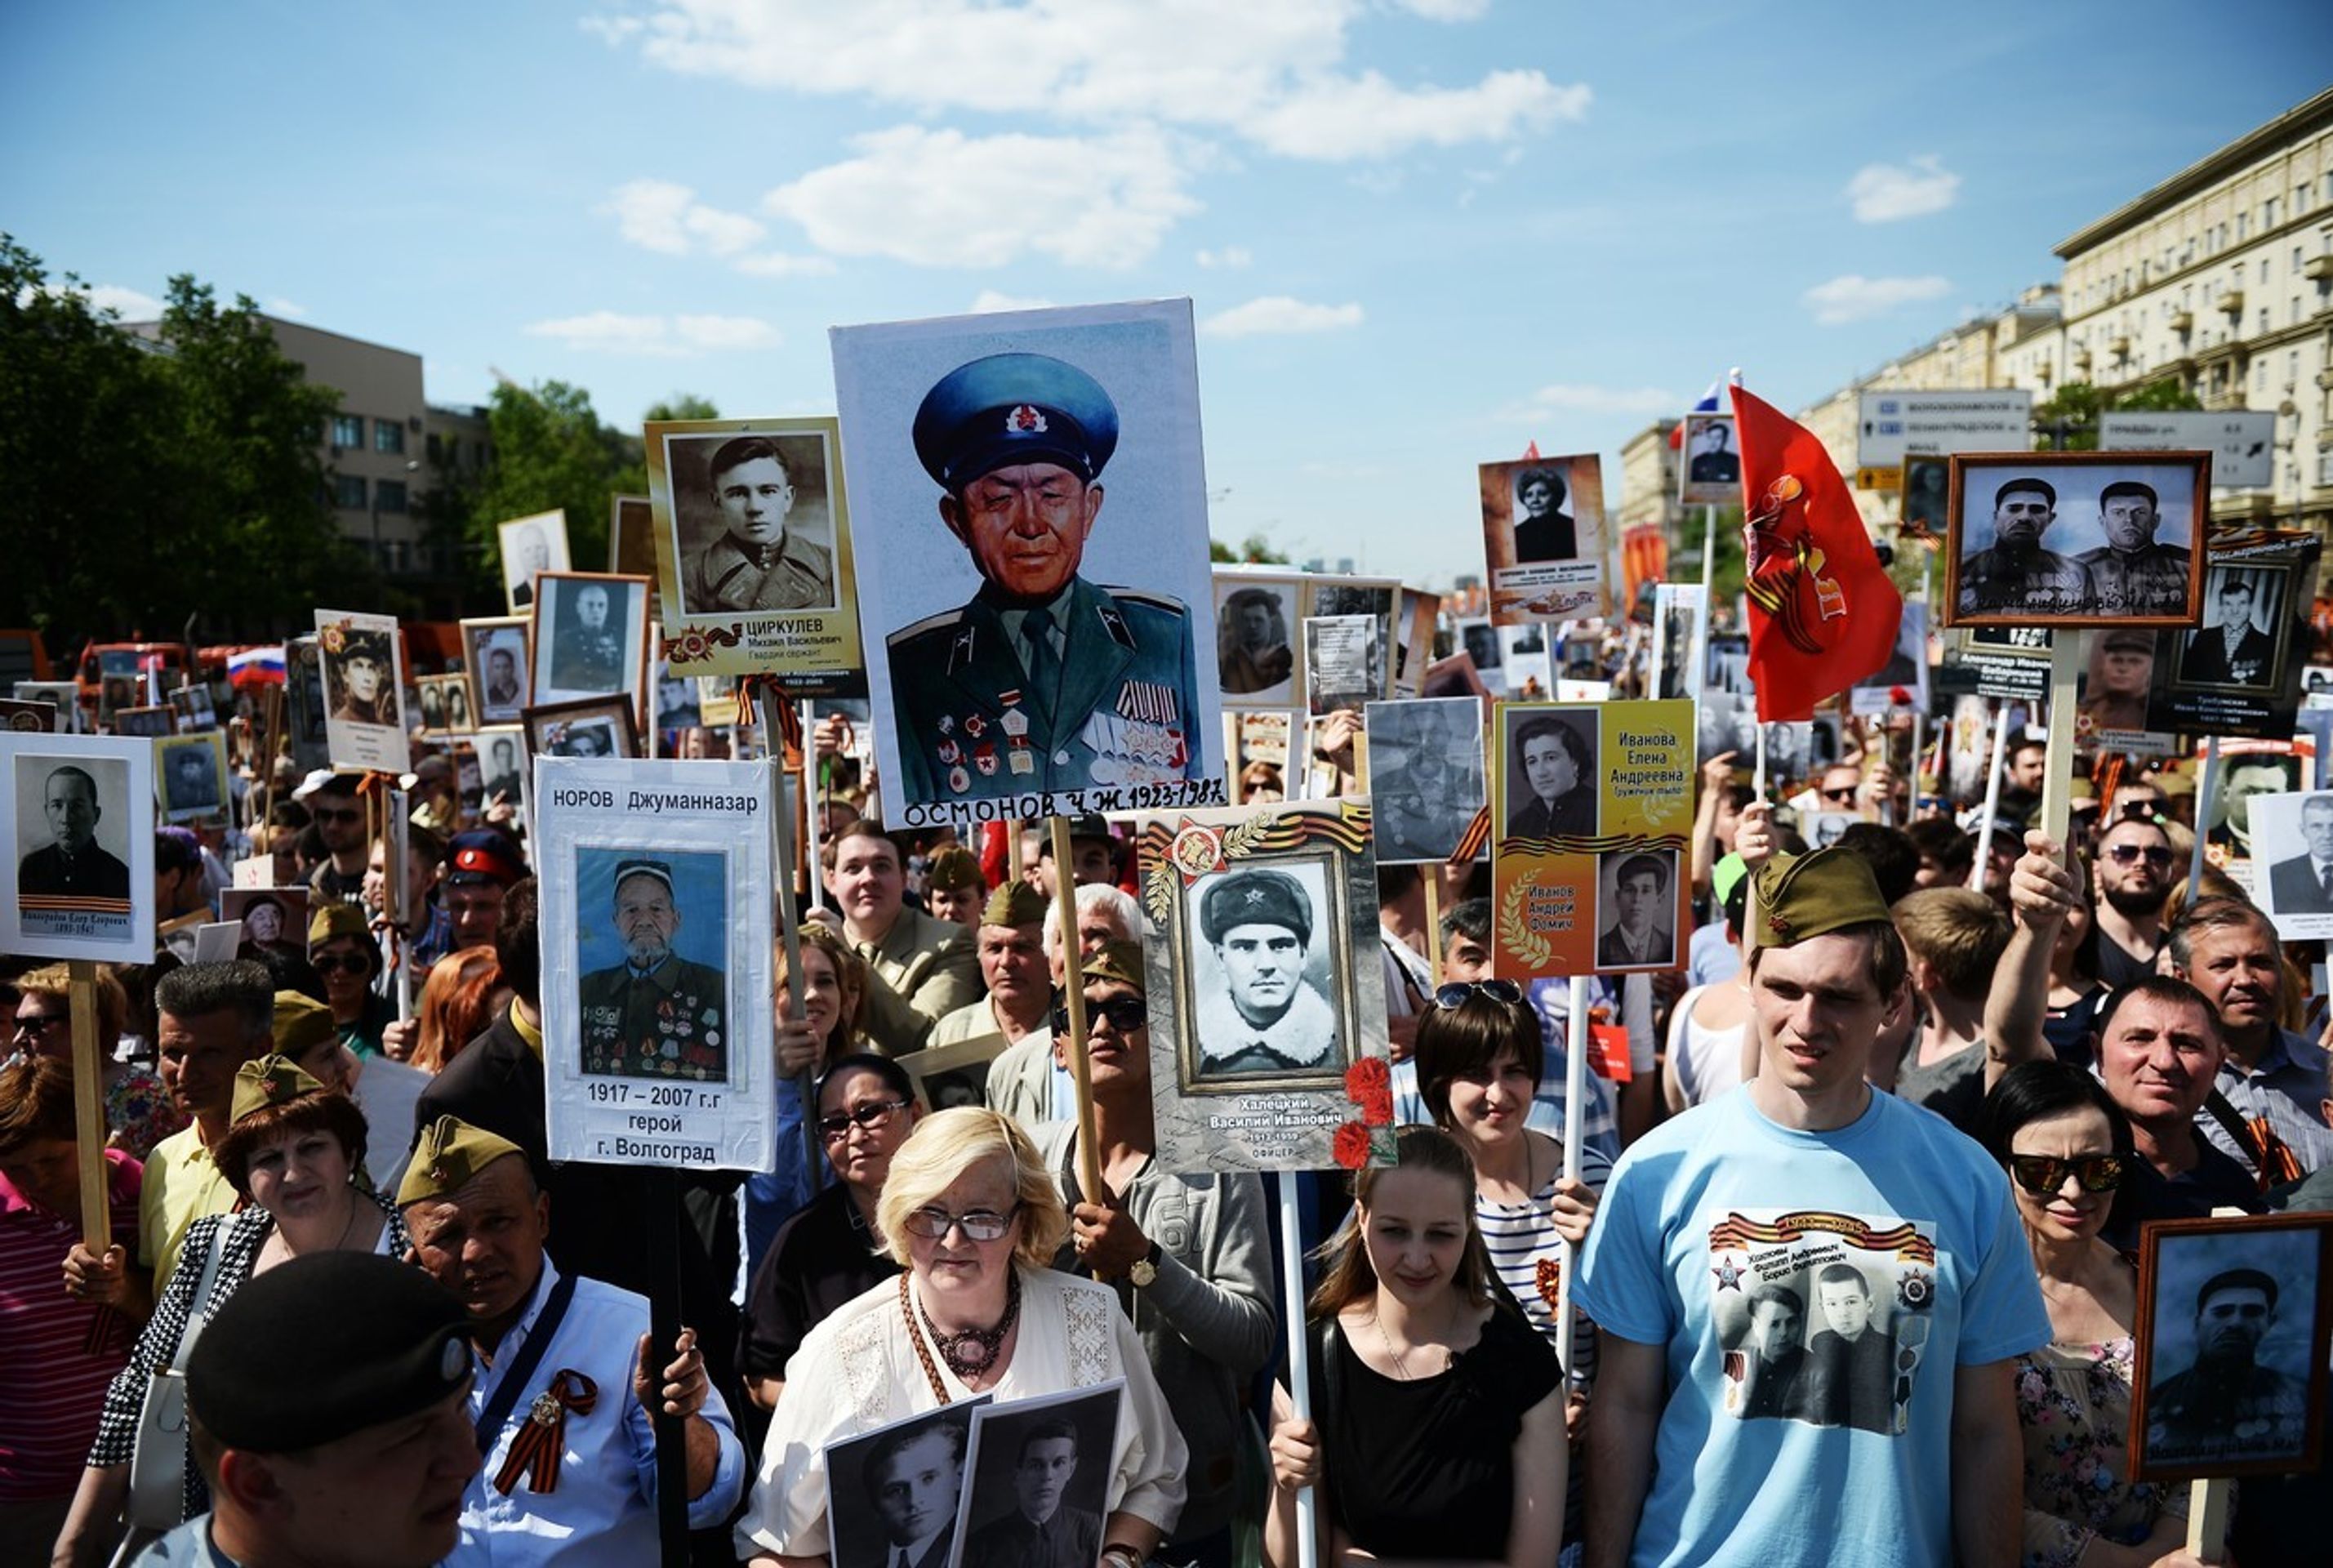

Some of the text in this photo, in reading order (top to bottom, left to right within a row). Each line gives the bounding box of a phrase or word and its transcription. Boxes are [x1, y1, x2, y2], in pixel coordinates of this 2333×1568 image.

[746, 618, 823, 636] ЦИРКУЛЕВ
[748, 635, 842, 648] Михаил Васильевич
[786, 648, 821, 659] сержант
[1619, 732, 1676, 746] Иванова
[1627, 751, 1667, 764] Елена
[1610, 769, 1684, 786] Андреевна
[554, 790, 758, 815] НОРОВ Джуманназар
[1528, 884, 1575, 898] Иванов
[1528, 902, 1575, 915] Андрей
[1530, 918, 1574, 931] Фомич
[588, 1083, 629, 1102] 1917
[651, 1086, 693, 1107] 2007
[1240, 1098, 1309, 1112] Халецкий
[629, 1115, 683, 1134] герой
[1210, 1112, 1343, 1129] Василий Иванович
[597, 1138, 716, 1164] г. Волгоград
[1252, 1148, 1294, 1158] ОФИЦЕР
[1791, 1243, 1839, 1263] Андреевич
